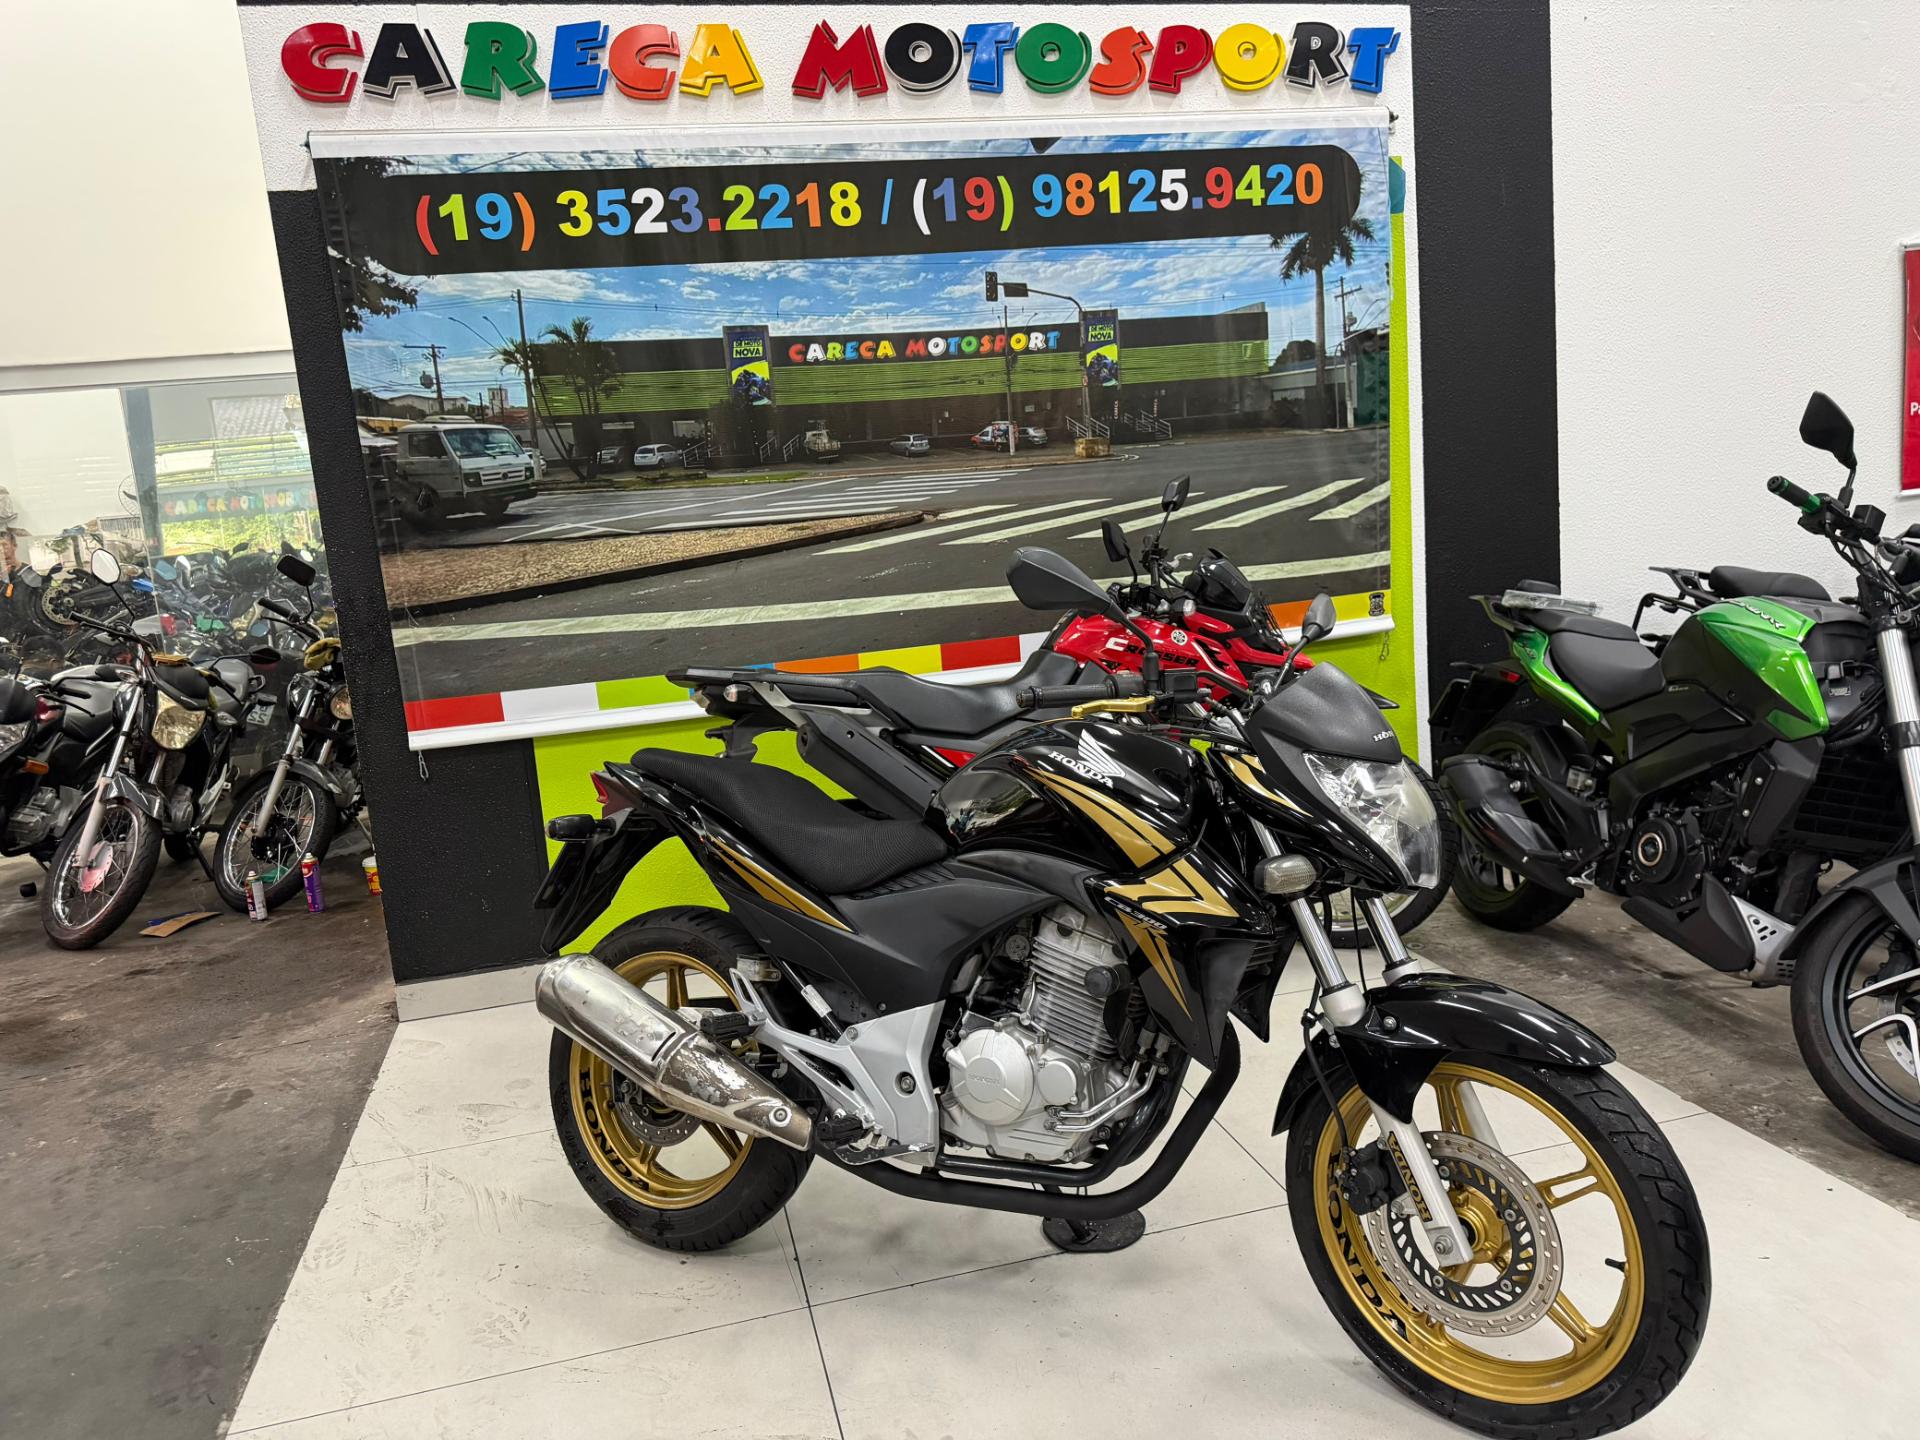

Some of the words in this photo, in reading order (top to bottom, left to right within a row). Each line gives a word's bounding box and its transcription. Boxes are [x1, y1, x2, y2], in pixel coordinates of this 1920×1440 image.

[281, 20, 764, 102] CARECA
[792, 19, 1400, 99] MOTOSPORT
[415, 191, 535, 255] (19)
[556, 181, 861, 237] 3523.2218
[880, 178, 895, 225] /
[913, 176, 1014, 235] (19)
[1032, 163, 1323, 217] 98125.9420
[735, 347, 761, 357] NOVA
[788, 339, 896, 363] CARECA
[905, 330, 1061, 358] MOTOSPORT
[1090, 331, 1112, 341] NOVA
[1105, 637, 1200, 667] CROSER
[1048, 751, 1114, 789] HONDA
[580, 1067, 650, 1191] HONDA
[1387, 1131, 1433, 1222] HONDA
